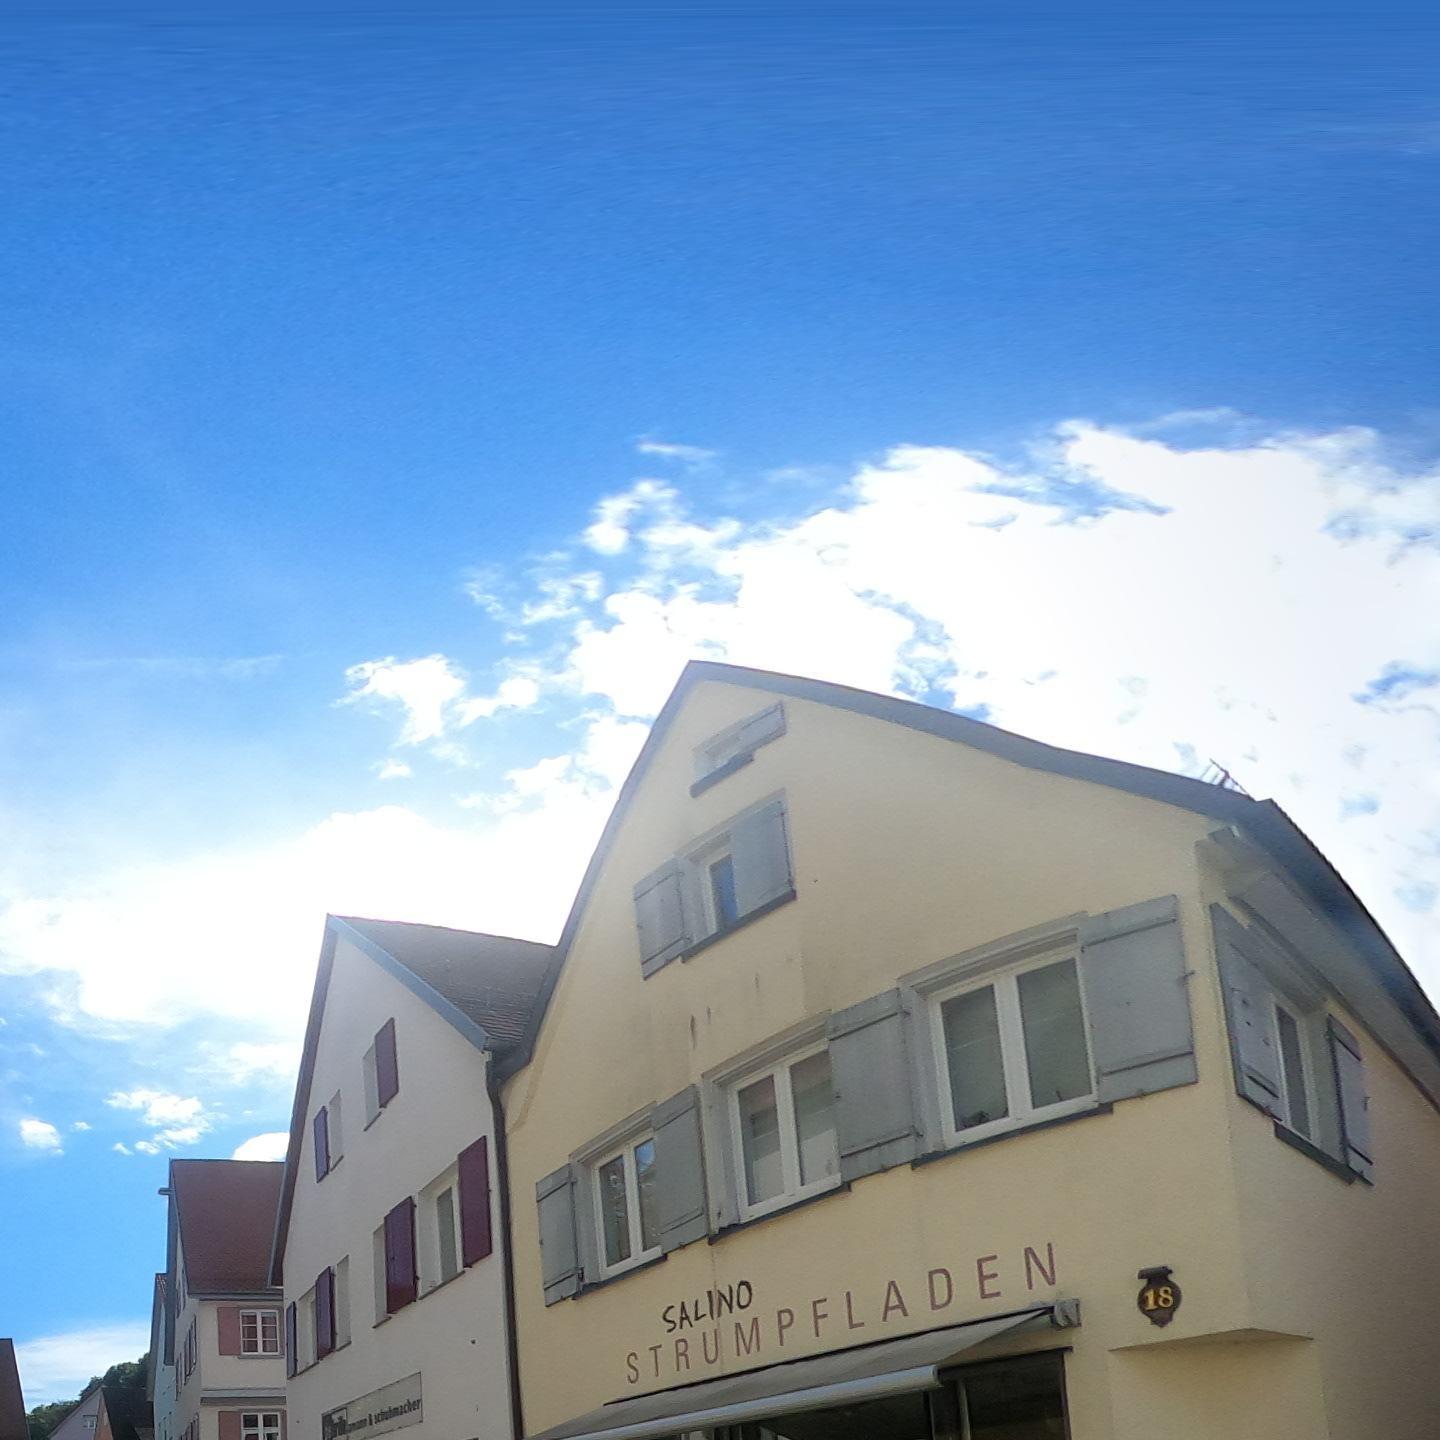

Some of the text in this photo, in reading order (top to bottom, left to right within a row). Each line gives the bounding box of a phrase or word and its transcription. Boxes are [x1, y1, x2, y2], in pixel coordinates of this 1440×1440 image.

[625, 1242, 1058, 1384] STRUMPFLADEN
[661, 1280, 754, 1333] SALINO
[1144, 1286, 1174, 1310] 18
